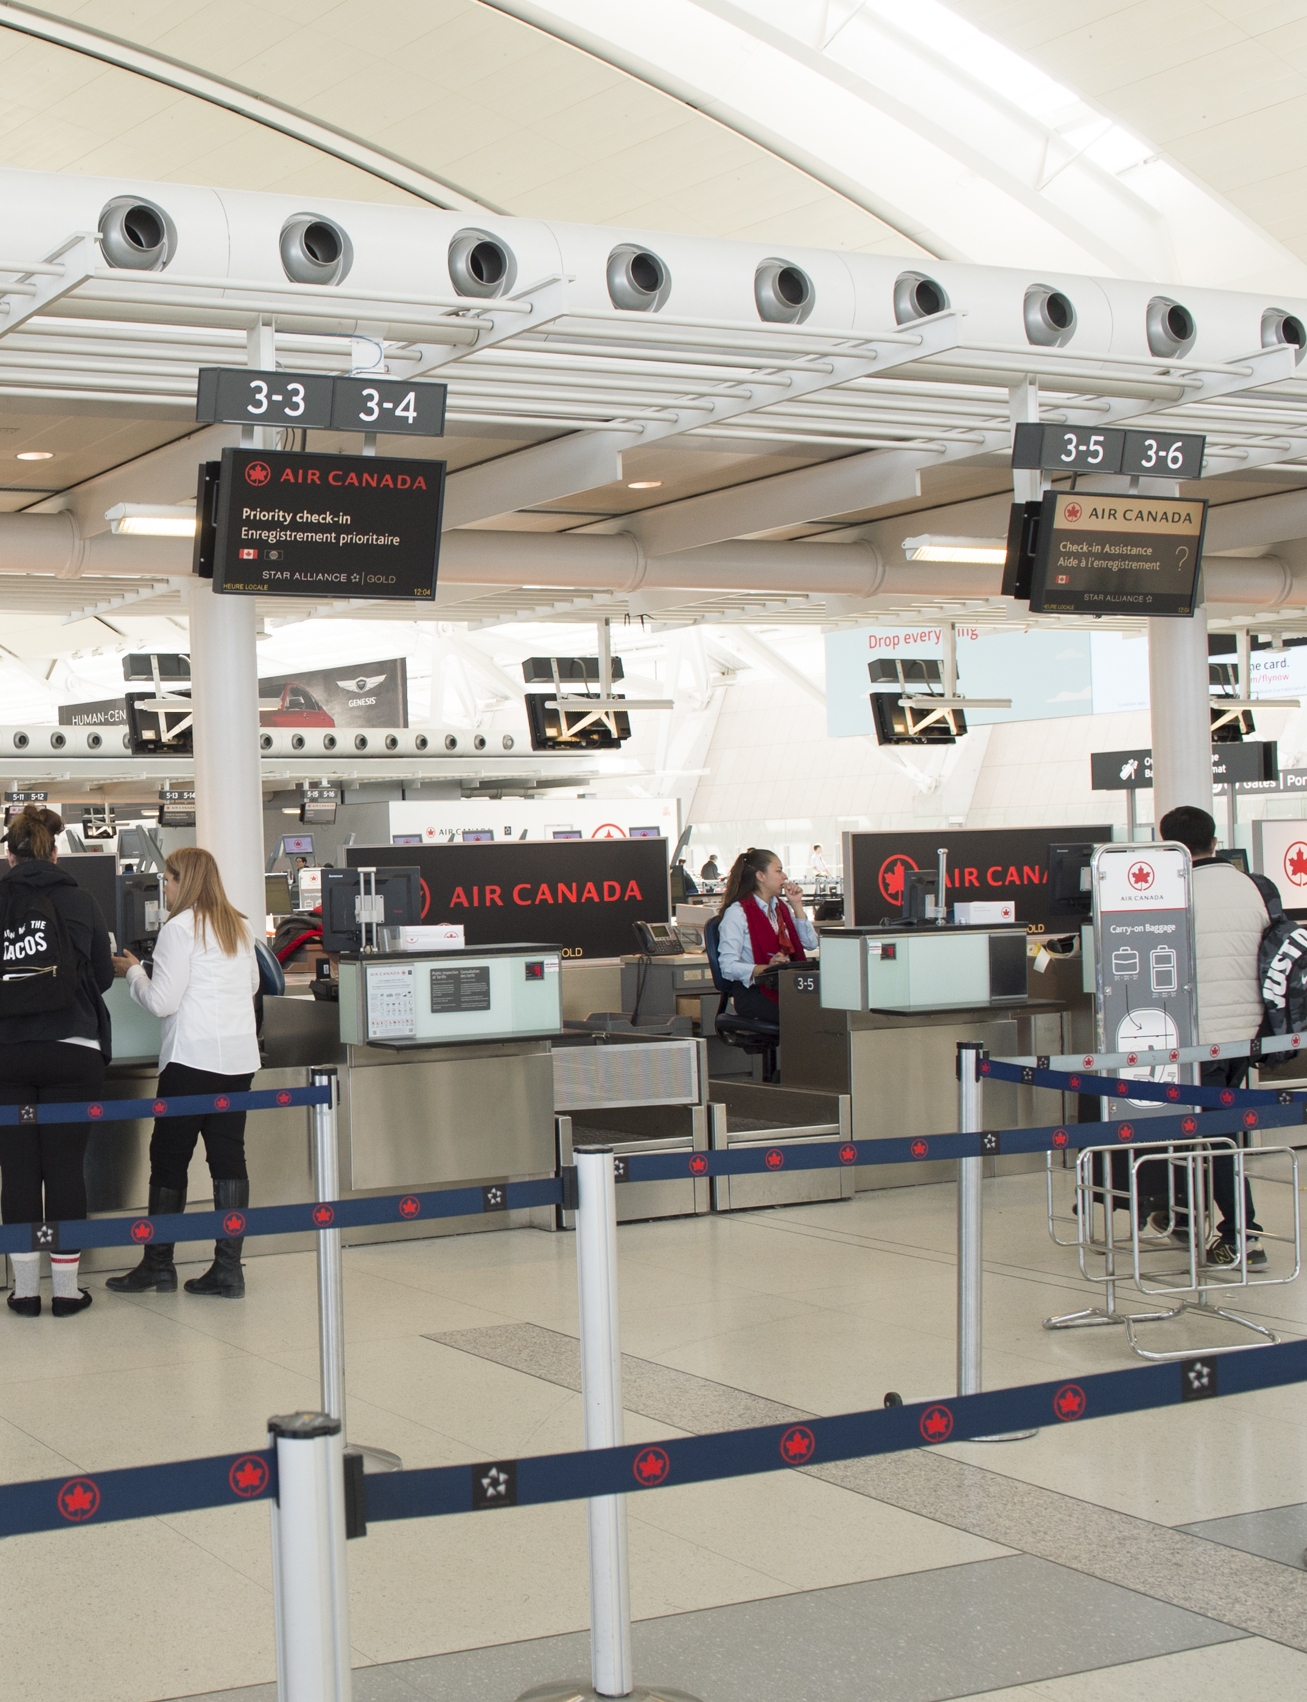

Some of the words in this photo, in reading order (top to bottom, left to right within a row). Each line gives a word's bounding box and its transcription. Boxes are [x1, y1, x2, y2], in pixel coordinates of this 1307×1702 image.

[246, 380, 305, 417] 3-3
[358, 388, 417, 424] 3-4
[1060, 433, 1105, 464] 3-5
[1141, 439, 1183, 469] 3-6
[280, 468, 321, 484] AIR
[328, 470, 427, 490] CANADA
[243, 508, 293, 525] Priority
[296, 509, 351, 524] check-in
[1089, 507, 1117, 520] AIR
[1123, 508, 1193, 524] CANADA
[241, 527, 336, 543] Enregistrement
[340, 532, 400, 546] prioritaire
[1060, 542, 1101, 554] Check-in
[1103, 544, 1152, 555] Assistance
[1058, 557, 1078, 567] Aide
[1080, 557, 1085, 567] à
[1088, 557, 1160, 571] l'enregistrement
[262, 571, 290, 580] STAR
[293, 571, 348, 582] ALLIANCE
[367, 574, 396, 583] GOLD
[1106, 594, 1144, 602] ALLIANCE
[869, 635, 900, 650] Drop
[904, 628, 978, 644] everying
[1263, 657, 1290, 670] card.
[348, 697, 376, 707] GENESIS
[72, 709, 126, 726] HUMAN-CEN
[987, 865, 1048, 886] CAN
[449, 885, 504, 908] AIR
[513, 880, 642, 906] CANADA
[30, 920, 46, 930] THE
[1025, 924, 1045, 933] OLD
[1110, 925, 1144, 935] Carry-on
[1145, 924, 1177, 934] Baggage
[559, 947, 583, 957] OLD
[1262, 939, 1303, 1009] JUST
[797, 977, 814, 990] 3-5
